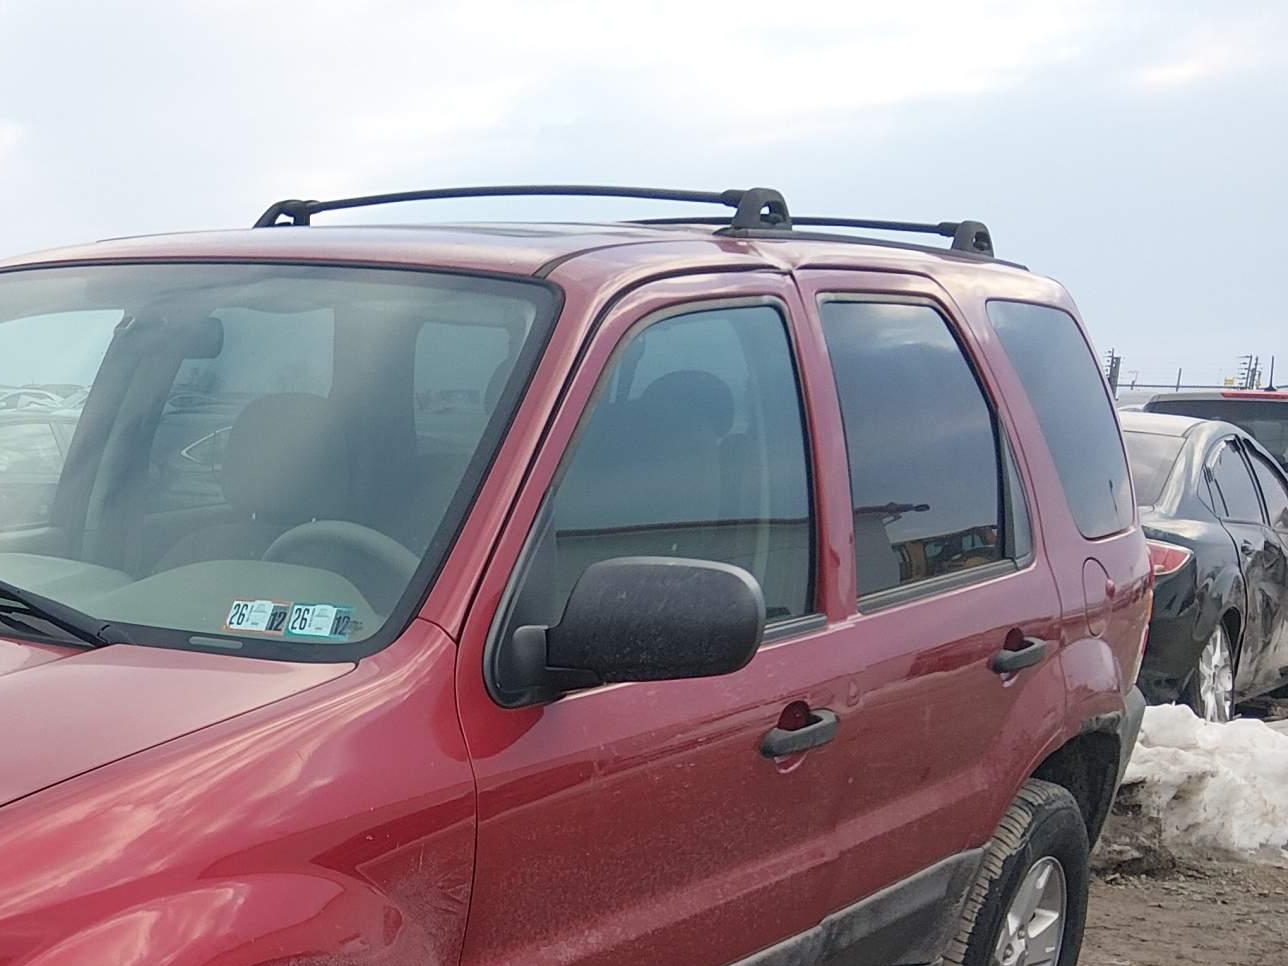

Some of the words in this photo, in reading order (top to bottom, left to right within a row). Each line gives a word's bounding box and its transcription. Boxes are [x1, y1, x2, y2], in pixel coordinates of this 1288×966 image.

[228, 602, 249, 626] 26
[265, 611, 288, 632] 12
[290, 607, 311, 631] 26
